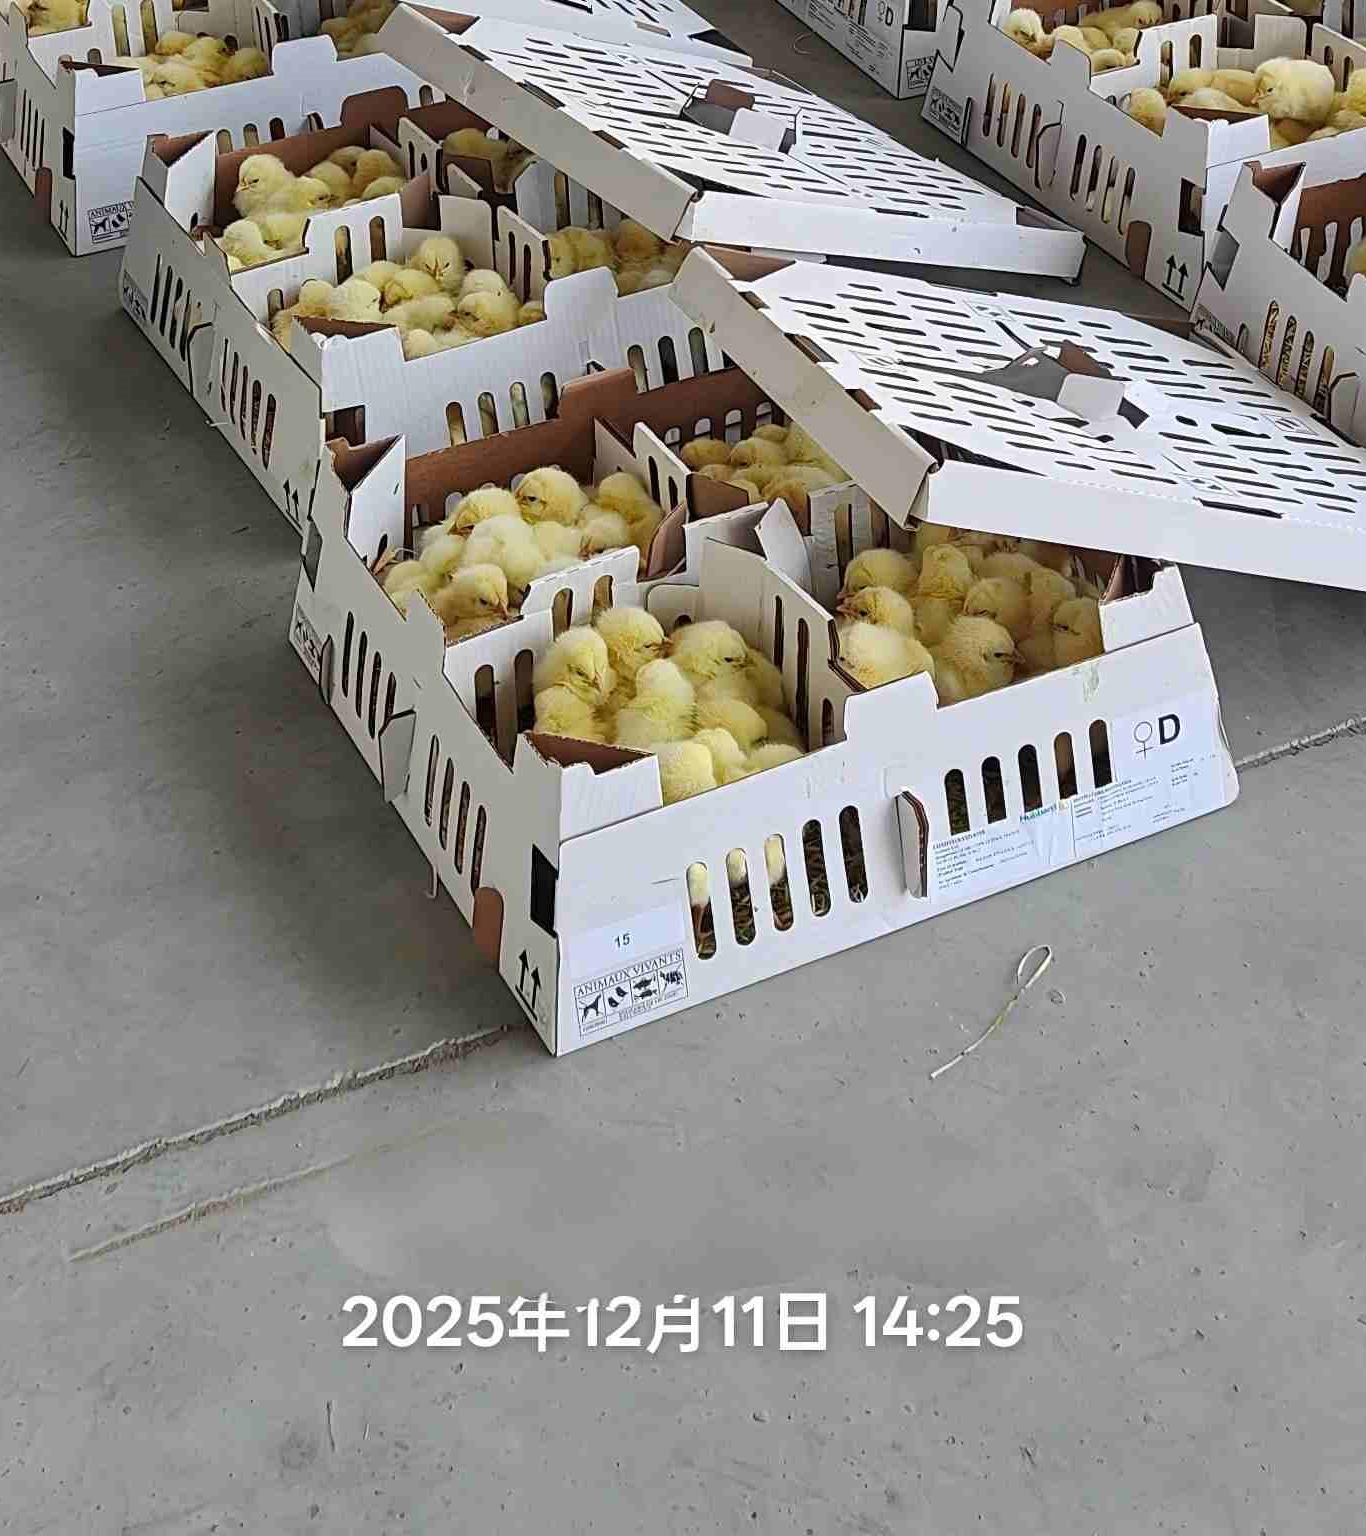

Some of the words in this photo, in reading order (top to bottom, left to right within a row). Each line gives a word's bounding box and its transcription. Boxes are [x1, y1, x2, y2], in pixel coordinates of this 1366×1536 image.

[885, 5, 894, 26] D
[1158, 713, 1181, 745] D
[614, 932, 632, 948] 15
[578, 969, 631, 996] ANIMAUX
[633, 951, 682, 975] VIVANTS
